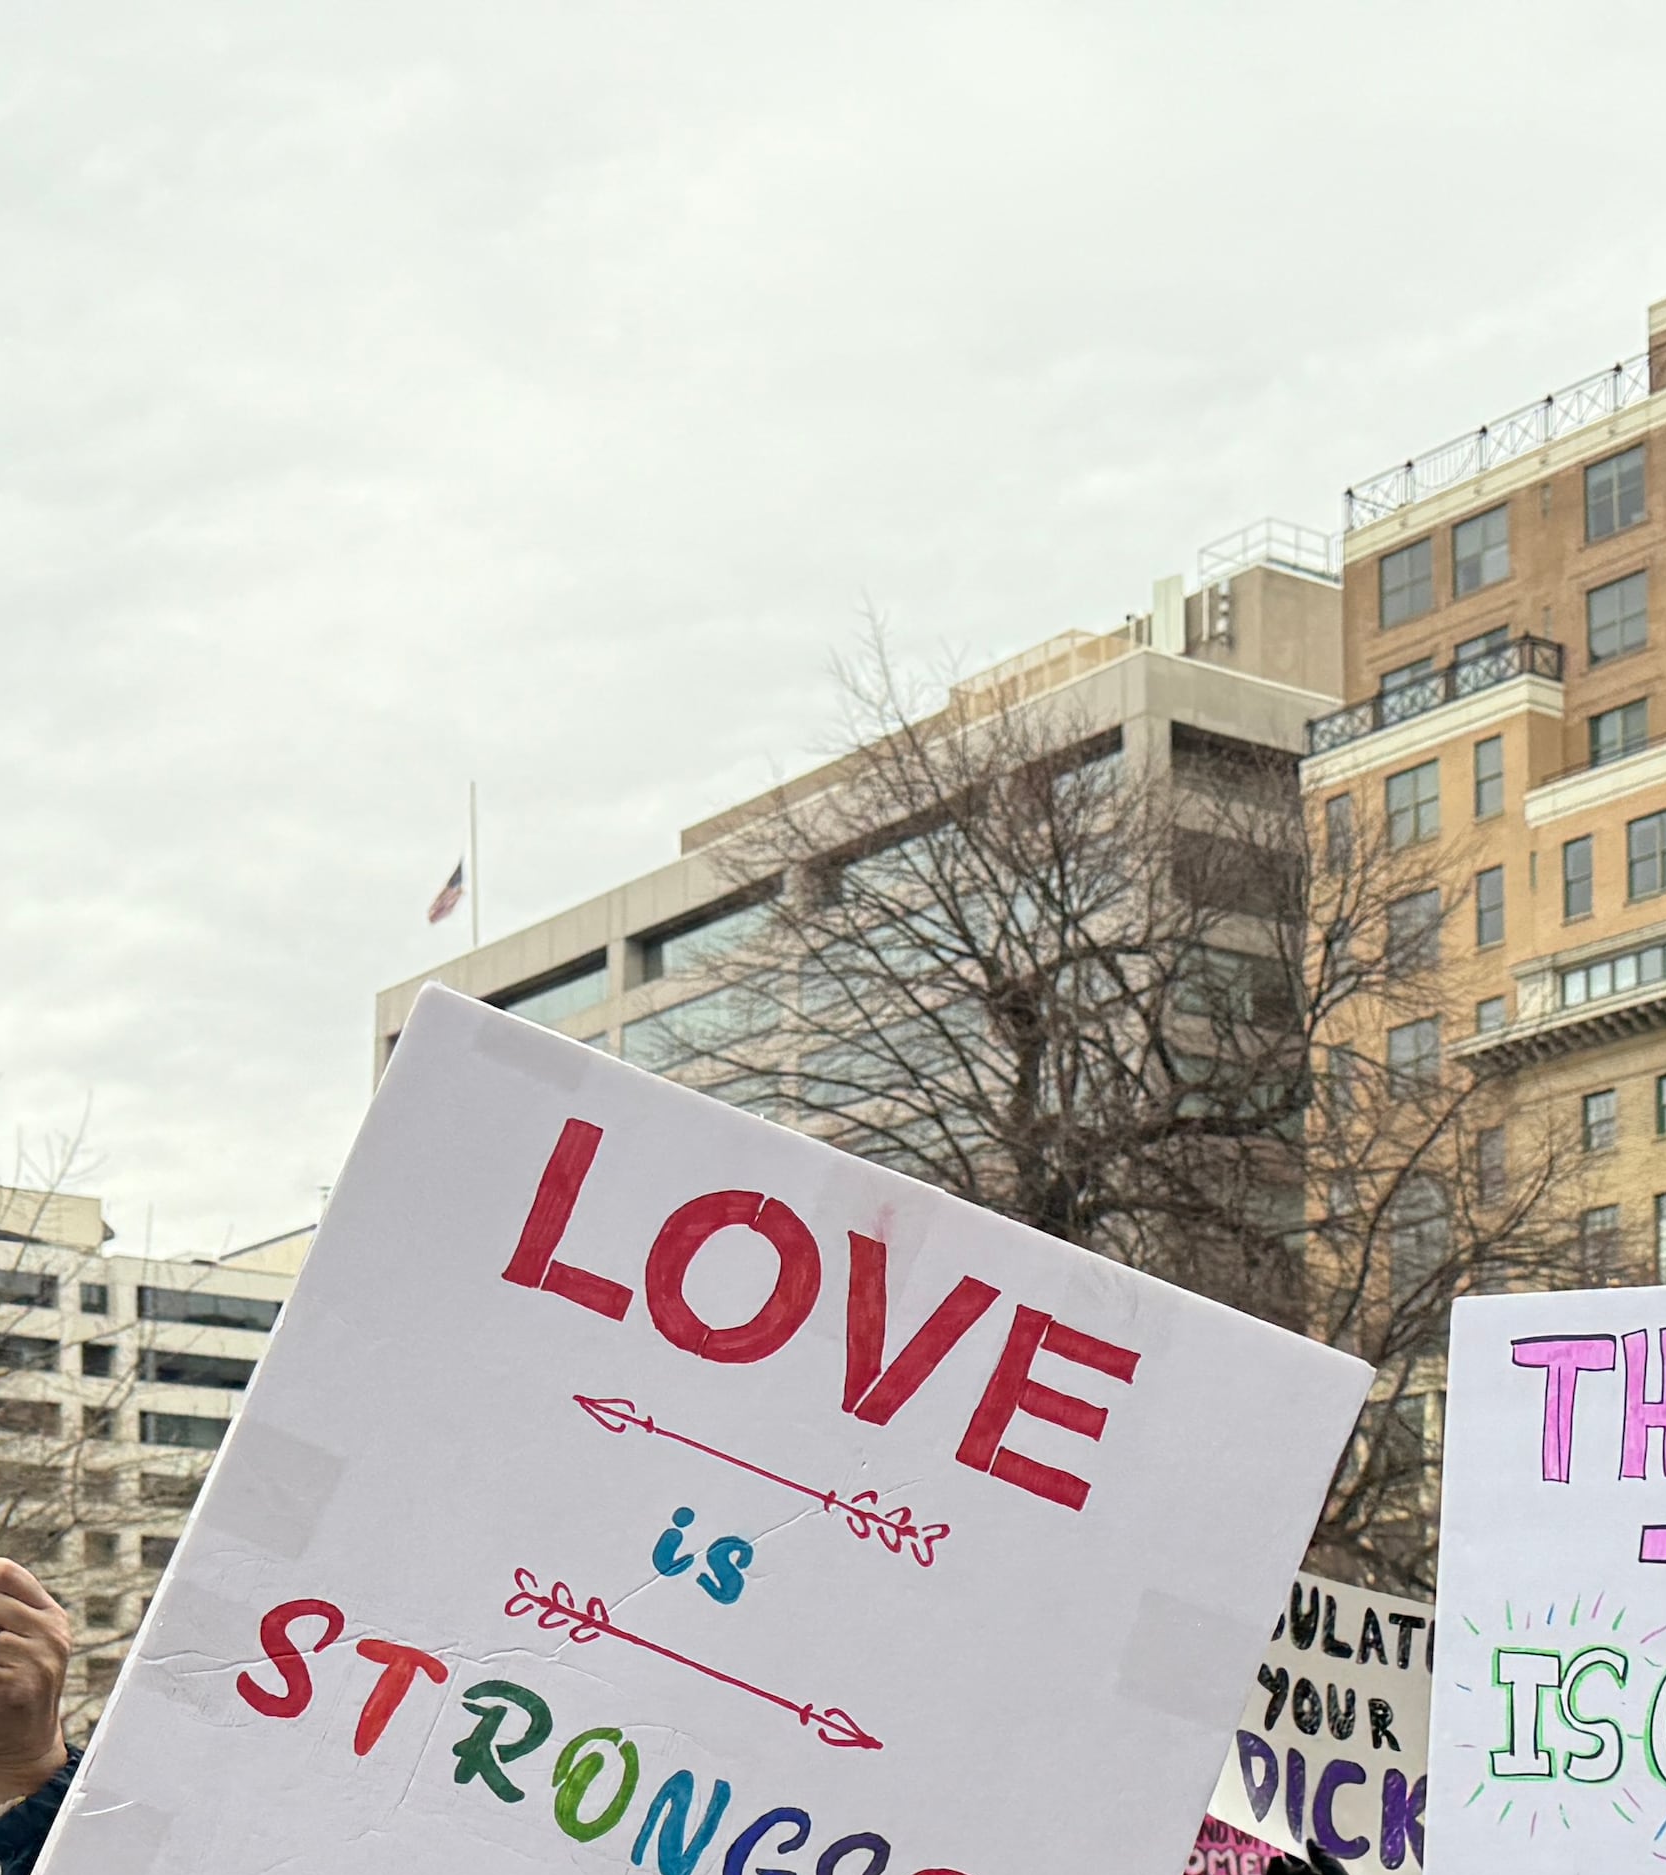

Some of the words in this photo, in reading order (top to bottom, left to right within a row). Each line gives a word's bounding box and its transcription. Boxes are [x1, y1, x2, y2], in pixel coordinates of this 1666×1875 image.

[499, 1116, 1139, 1511] LOVE
[651, 1505, 757, 1607] is
[1257, 1662, 1402, 1753] YOUR
[1489, 1644, 1629, 1785] IS
[1236, 1728, 1427, 1872] DICK
